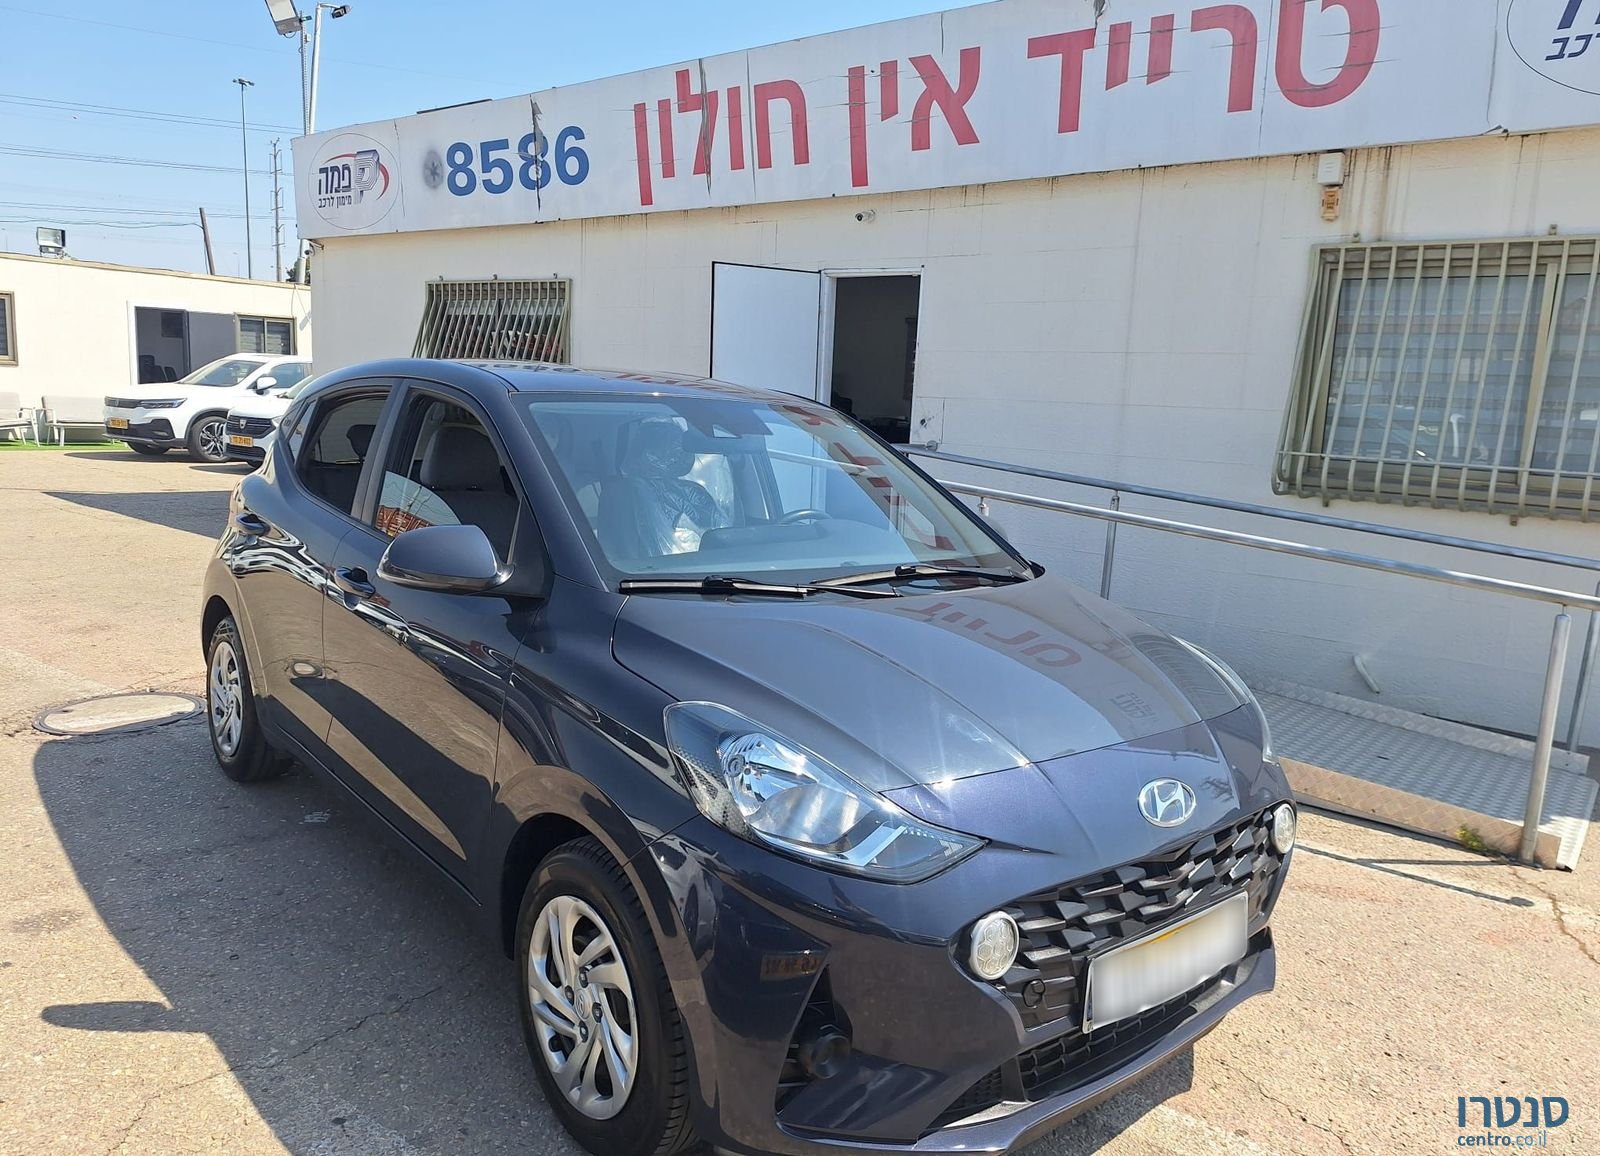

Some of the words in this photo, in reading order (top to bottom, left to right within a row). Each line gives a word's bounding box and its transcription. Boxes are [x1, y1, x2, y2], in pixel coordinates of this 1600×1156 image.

[1027, 0, 1381, 135] טרייד
[1545, 32, 1600, 61] כב
[633, 68, 810, 206] חולון
[848, 46, 982, 188] אין
[318, 195, 335, 208] לרכב
